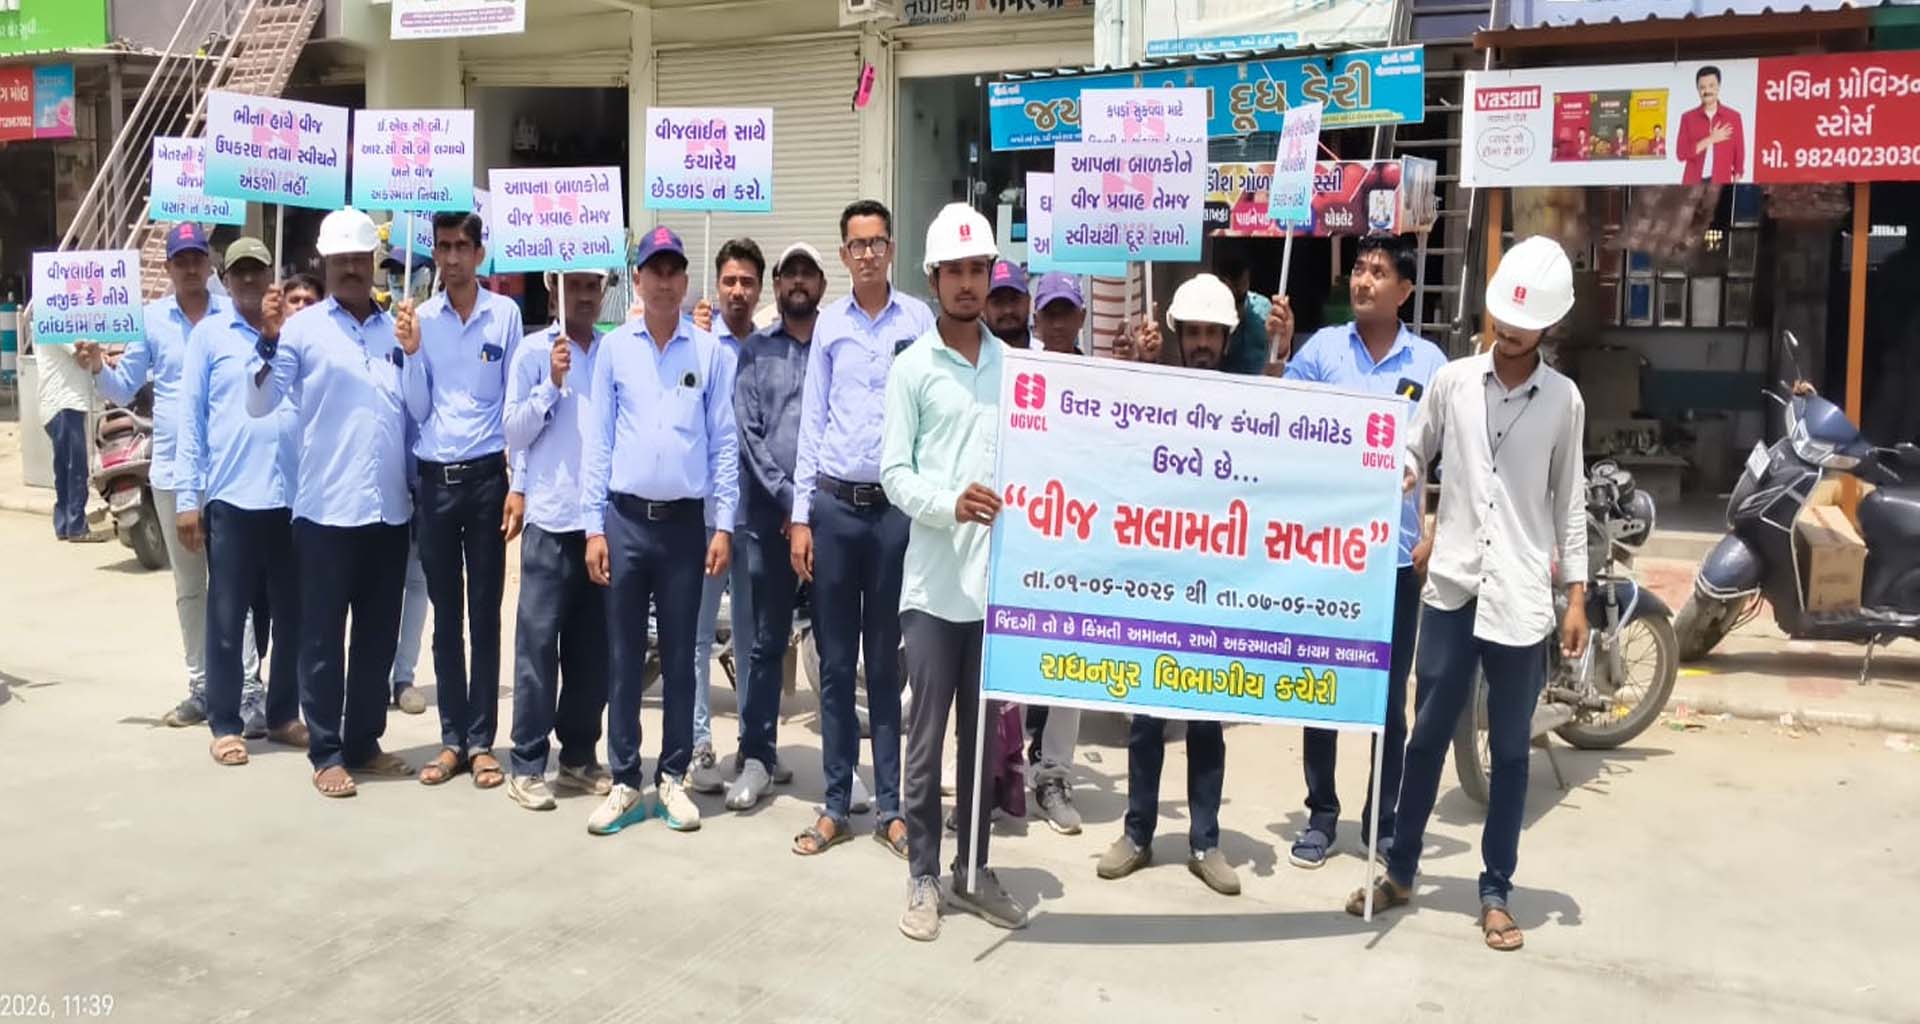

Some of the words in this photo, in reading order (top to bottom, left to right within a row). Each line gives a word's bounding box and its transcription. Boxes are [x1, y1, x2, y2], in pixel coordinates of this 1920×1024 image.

[1229, 78, 1287, 132] દૂધ
[1301, 60, 1372, 108] ડેરી
[1764, 71, 1830, 101] સચિન
[1477, 89, 1538, 108] vasant
[234, 105, 264, 126] ભીના
[299, 113, 323, 133] વીજ
[655, 118, 727, 140] વીજલાઈન
[734, 118, 765, 141] સાથે
[1816, 104, 1875, 137] સ્ટોર્સ
[215, 135, 262, 158] ઉપકરણ
[298, 146, 337, 167] સ્વીચને
[434, 141, 465, 155] લગાવો
[1762, 140, 1788, 168] મો.
[1795, 148, 1920, 168] 9824023030
[391, 165, 410, 178] અને
[415, 165, 434, 178] વીજ
[1072, 157, 1120, 173] આપના
[1128, 150, 1193, 173] બાળકોને
[240, 172, 276, 192] અડશો
[504, 181, 548, 195] આપના
[555, 173, 609, 193] બાળકોને
[651, 176, 705, 199] છેડછાડ
[712, 185, 726, 199] ન
[734, 178, 765, 200] કરો.
[190, 204, 198, 214] ન
[1071, 186, 1101, 210] વીજ
[1107, 194, 1145, 210] પ્રવાહ
[1153, 188, 1190, 210] તેમજ
[507, 207, 533, 226] વીજ
[540, 211, 573, 226] પ્રવાહ
[579, 205, 611, 224] તેમજ
[505, 238, 553, 257] સ્વીચથી
[560, 242, 575, 261] દૂર
[582, 236, 615, 255] રાખો.
[1065, 223, 1119, 245] સ્વીચથી
[1125, 231, 1144, 253] દૂર
[1152, 224, 1189, 245] રાખો.
[111, 260, 126, 278] ની
[47, 293, 79, 311] નજીક
[86, 288, 96, 305] કે
[103, 287, 128, 304] નીચે
[95, 321, 105, 332] ન
[112, 314, 139, 332] કરો.
[1011, 413, 1048, 432] UGVCL
[1061, 390, 1100, 417] ઉત્તર
[1110, 402, 1177, 429] ગુજરાત
[1187, 403, 1222, 430] વીજ
[1231, 409, 1280, 438] કંપની
[1288, 415, 1353, 445] લીમીટેડ
[1153, 445, 1203, 477] ઉજવે
[1214, 450, 1258, 483] છે...
[1362, 452, 1396, 470] UGVCL
[1114, 499, 1248, 556] સલામતી
[1185, 579, 1206, 604] થી
[995, 611, 1035, 631] જિંદગી
[1043, 620, 1056, 633] તો
[1063, 617, 1075, 635] છે
[1082, 619, 1121, 640] કિંમતી
[1127, 627, 1181, 647] અમાનત,
[1189, 631, 1217, 648] રાખો
[1297, 645, 1329, 659] કાયમ
[1335, 648, 1379, 663] સલામત.
[1153, 653, 1265, 699] વિભાગીય
[1275, 667, 1337, 705] કચેરી
